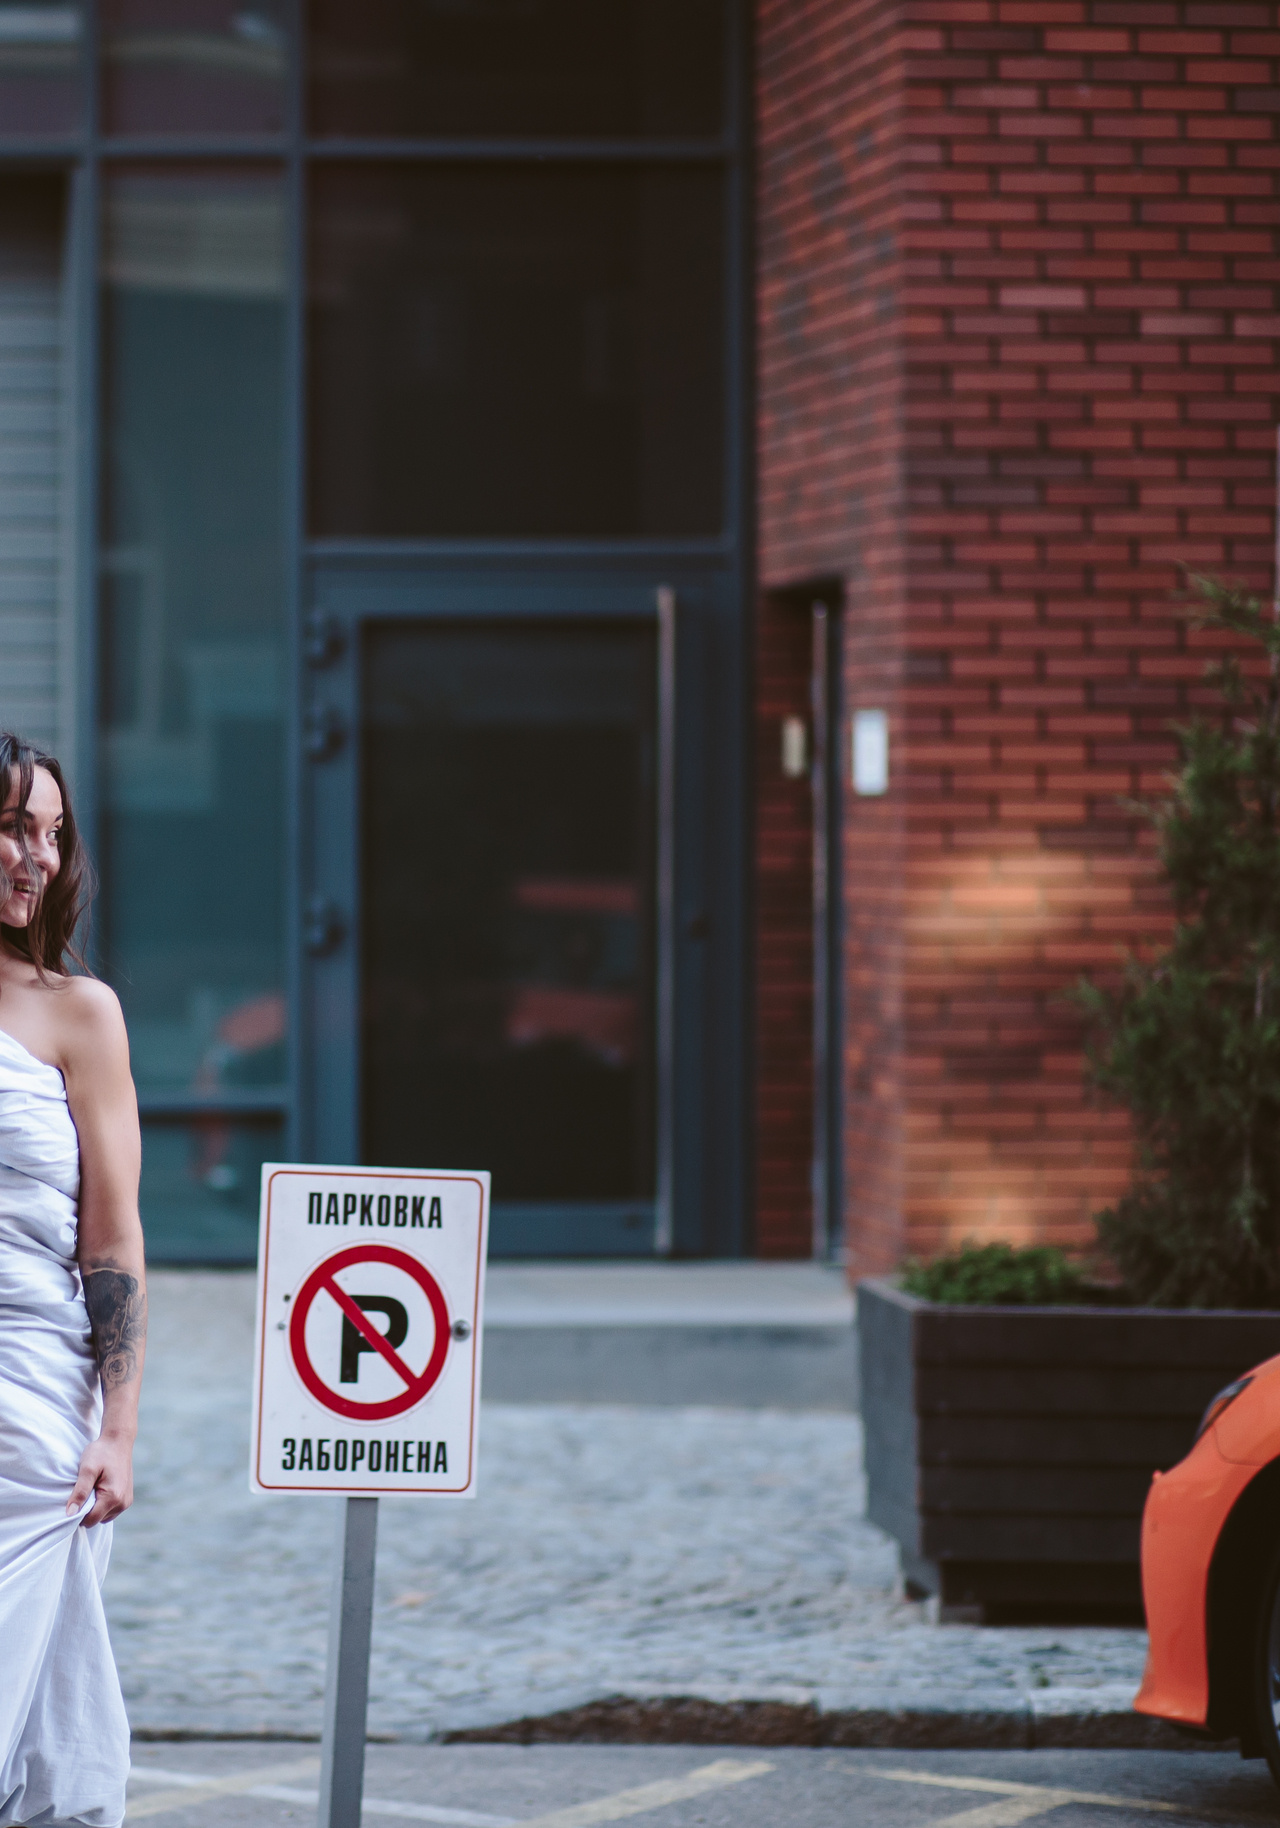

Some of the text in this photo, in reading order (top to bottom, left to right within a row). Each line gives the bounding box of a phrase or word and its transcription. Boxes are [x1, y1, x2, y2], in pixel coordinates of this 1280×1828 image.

[308, 1192, 443, 1229] ПАРКОВКА
[339, 1294, 409, 1384] P
[282, 1438, 448, 1473] ЗАБОРОНЕНА
